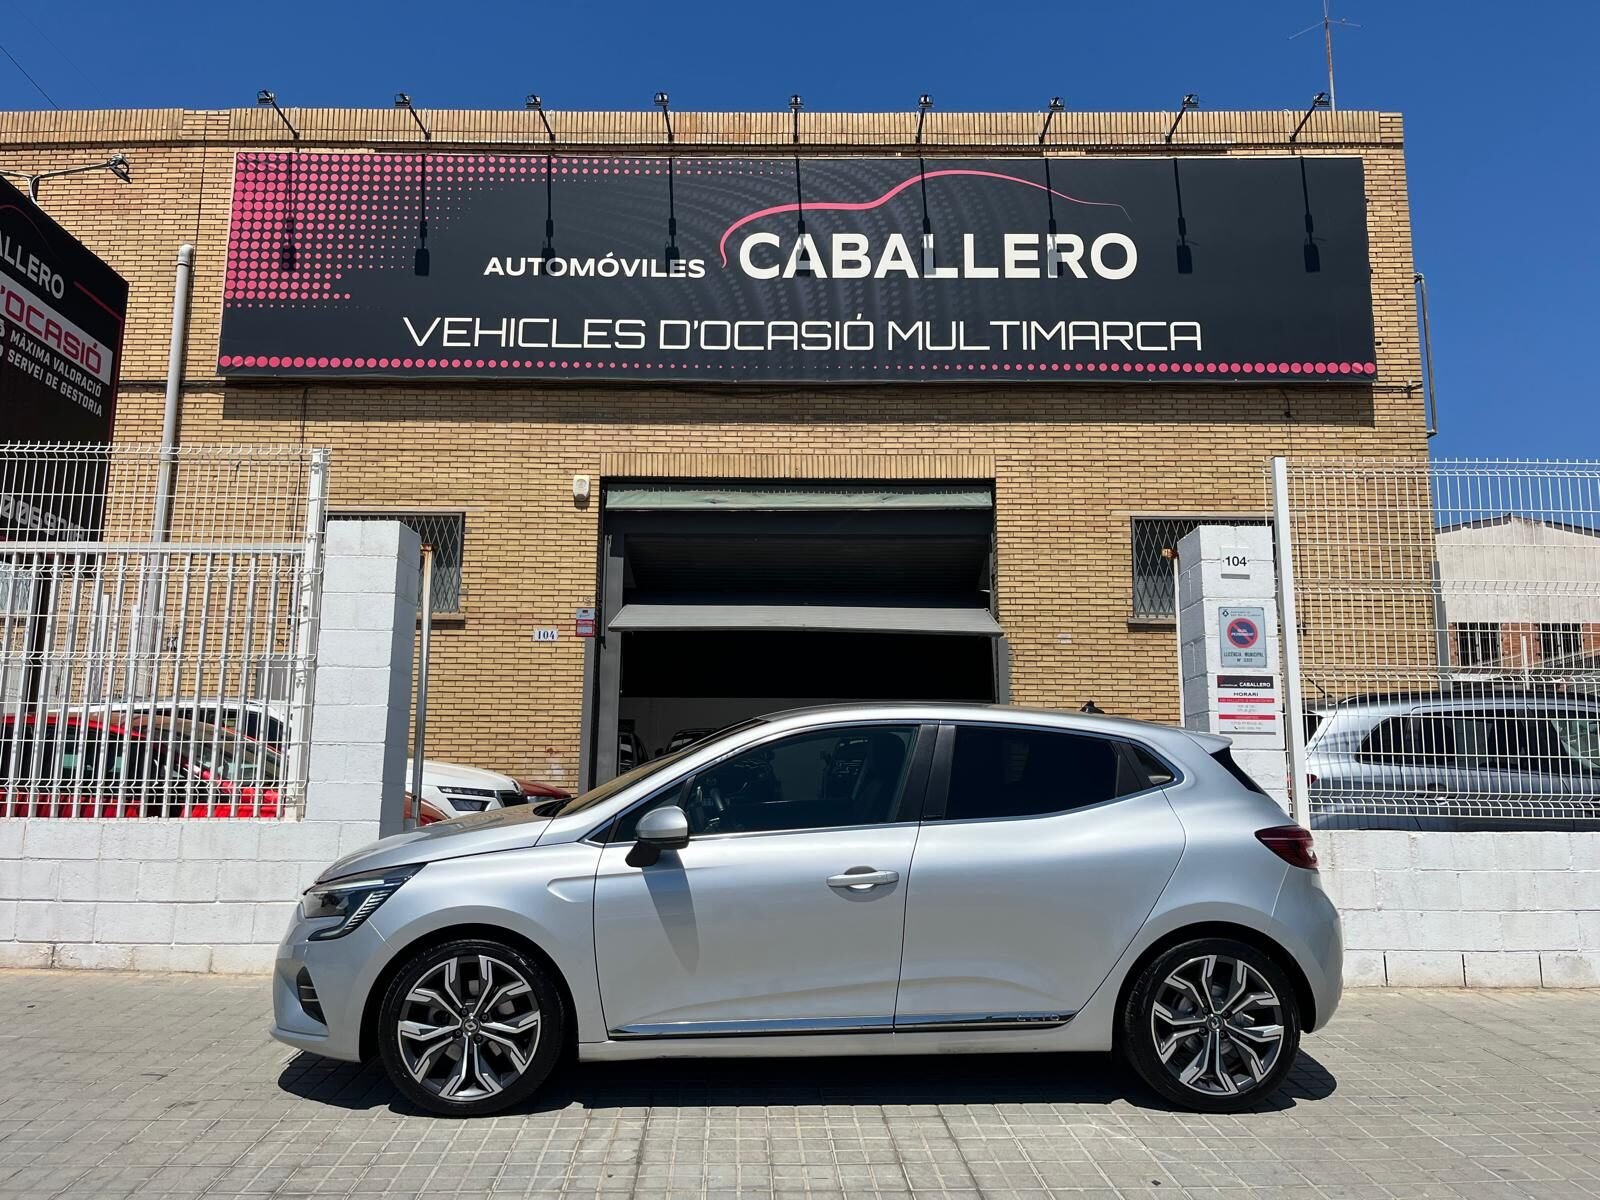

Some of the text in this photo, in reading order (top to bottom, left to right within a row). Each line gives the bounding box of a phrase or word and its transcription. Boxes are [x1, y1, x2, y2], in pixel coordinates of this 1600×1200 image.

[483, 232, 1138, 280] AUTOMÓVILES CABALLERO
[403, 312, 1203, 352] VEHICLES D'OCASIÓ MULTIMARCA
[7, 349, 44, 381] SERVEI
[45, 371, 59, 390] DE
[60, 382, 103, 417] GESTORIA
[1225, 556, 1247, 567] 104
[538, 631, 555, 640] 104
